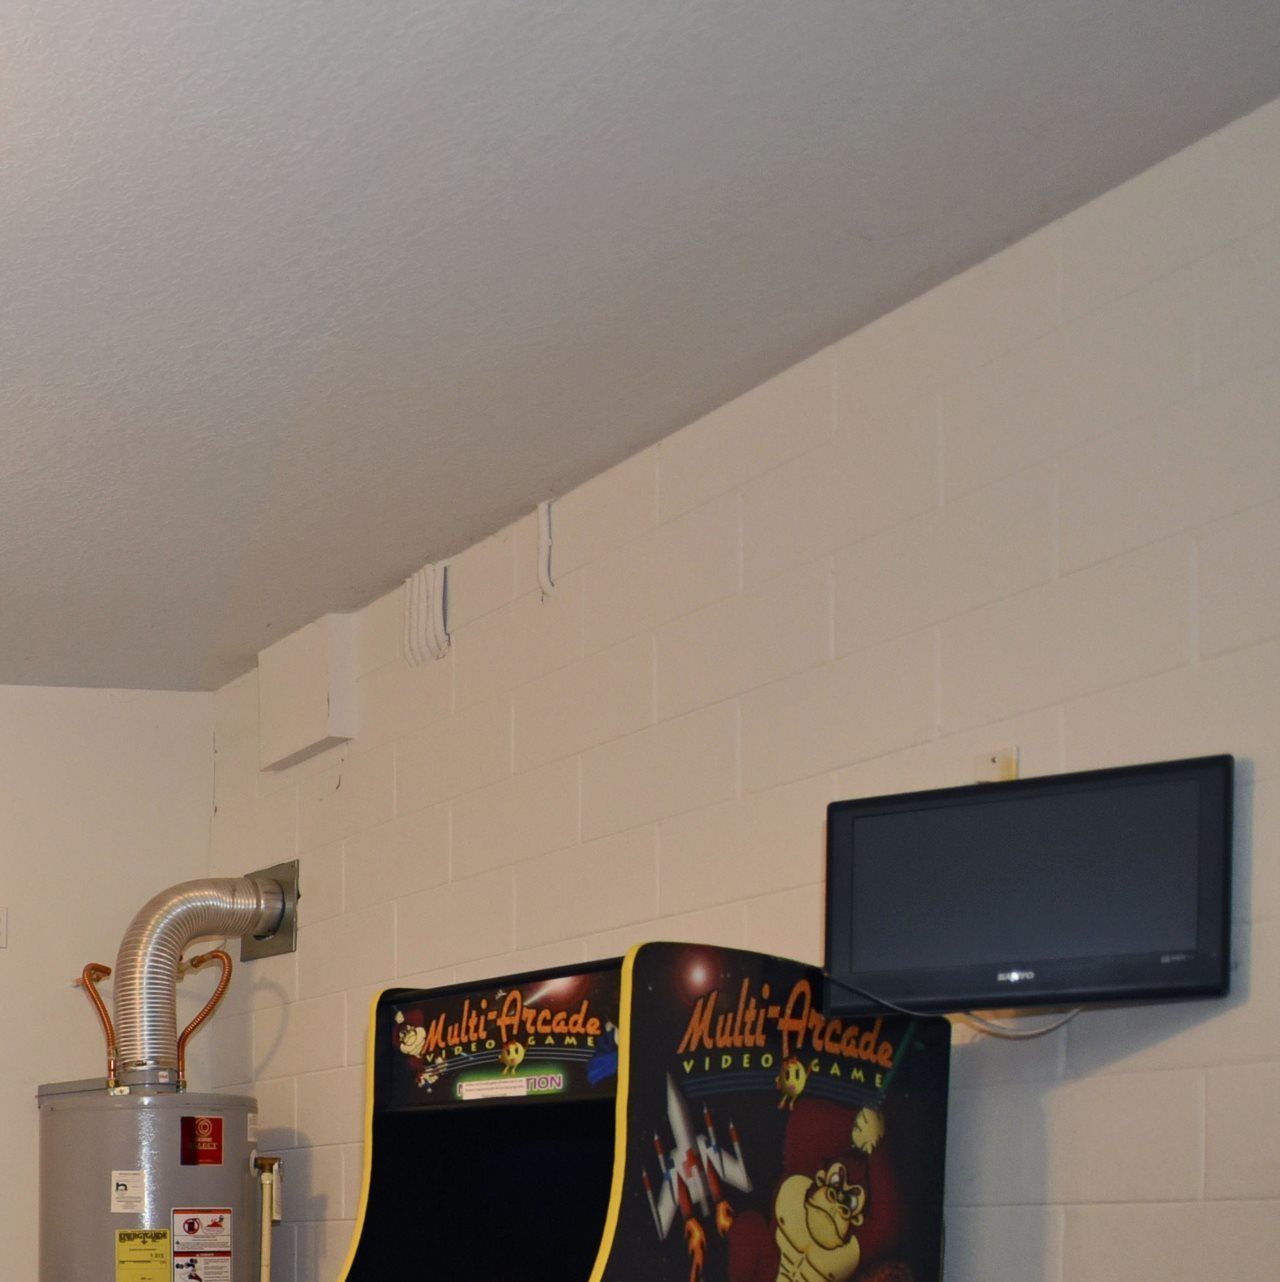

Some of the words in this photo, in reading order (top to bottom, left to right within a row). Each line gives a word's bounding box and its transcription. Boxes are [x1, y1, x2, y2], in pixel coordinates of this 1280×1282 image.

[421, 989, 602, 1055] Multi-Arcade
[676, 977, 894, 1069] Multi-Arcade
[426, 1039, 496, 1063] VIDEO
[528, 1036, 595, 1047] GAME
[683, 1053, 773, 1074] VIDEO
[811, 1058, 884, 1089] GAME
